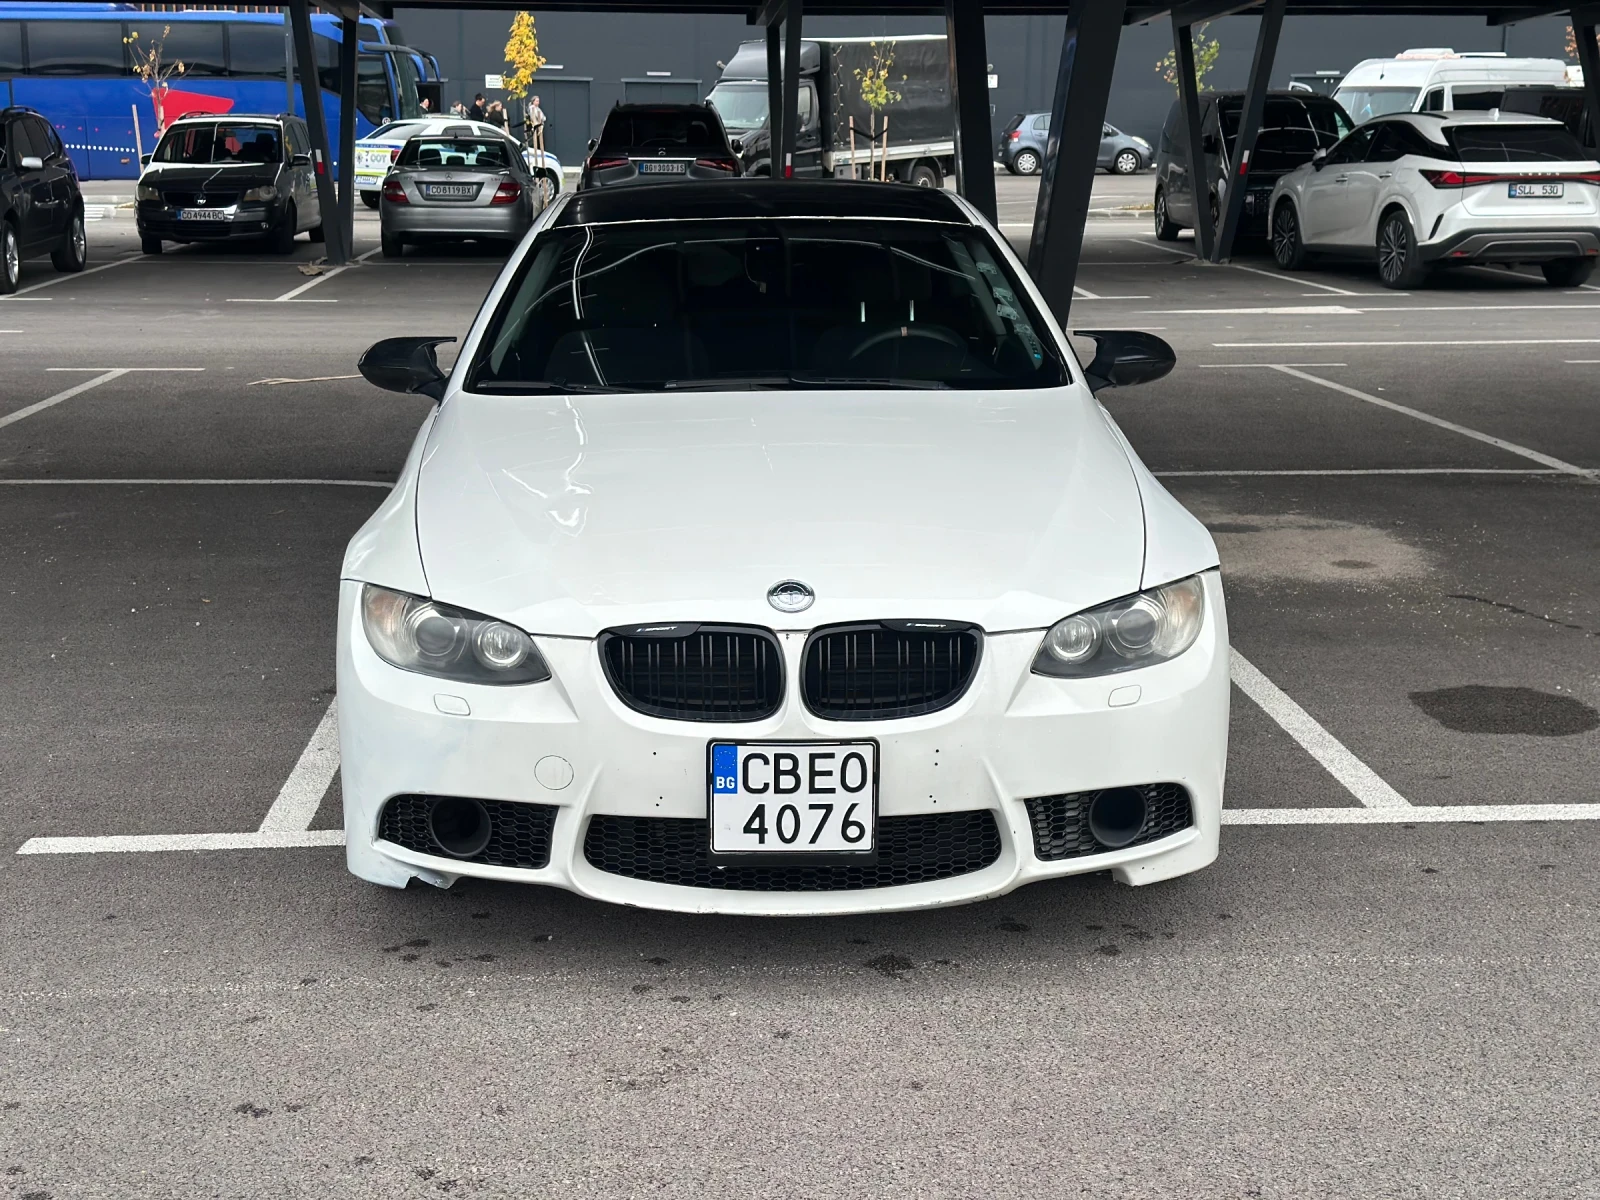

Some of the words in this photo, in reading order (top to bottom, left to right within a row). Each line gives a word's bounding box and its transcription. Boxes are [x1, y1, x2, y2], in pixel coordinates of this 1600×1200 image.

[1517, 185, 1535, 195] SLL
[1542, 185, 1559, 195] 530
[716, 776, 735, 789] BG
[742, 803, 866, 845] 4076
